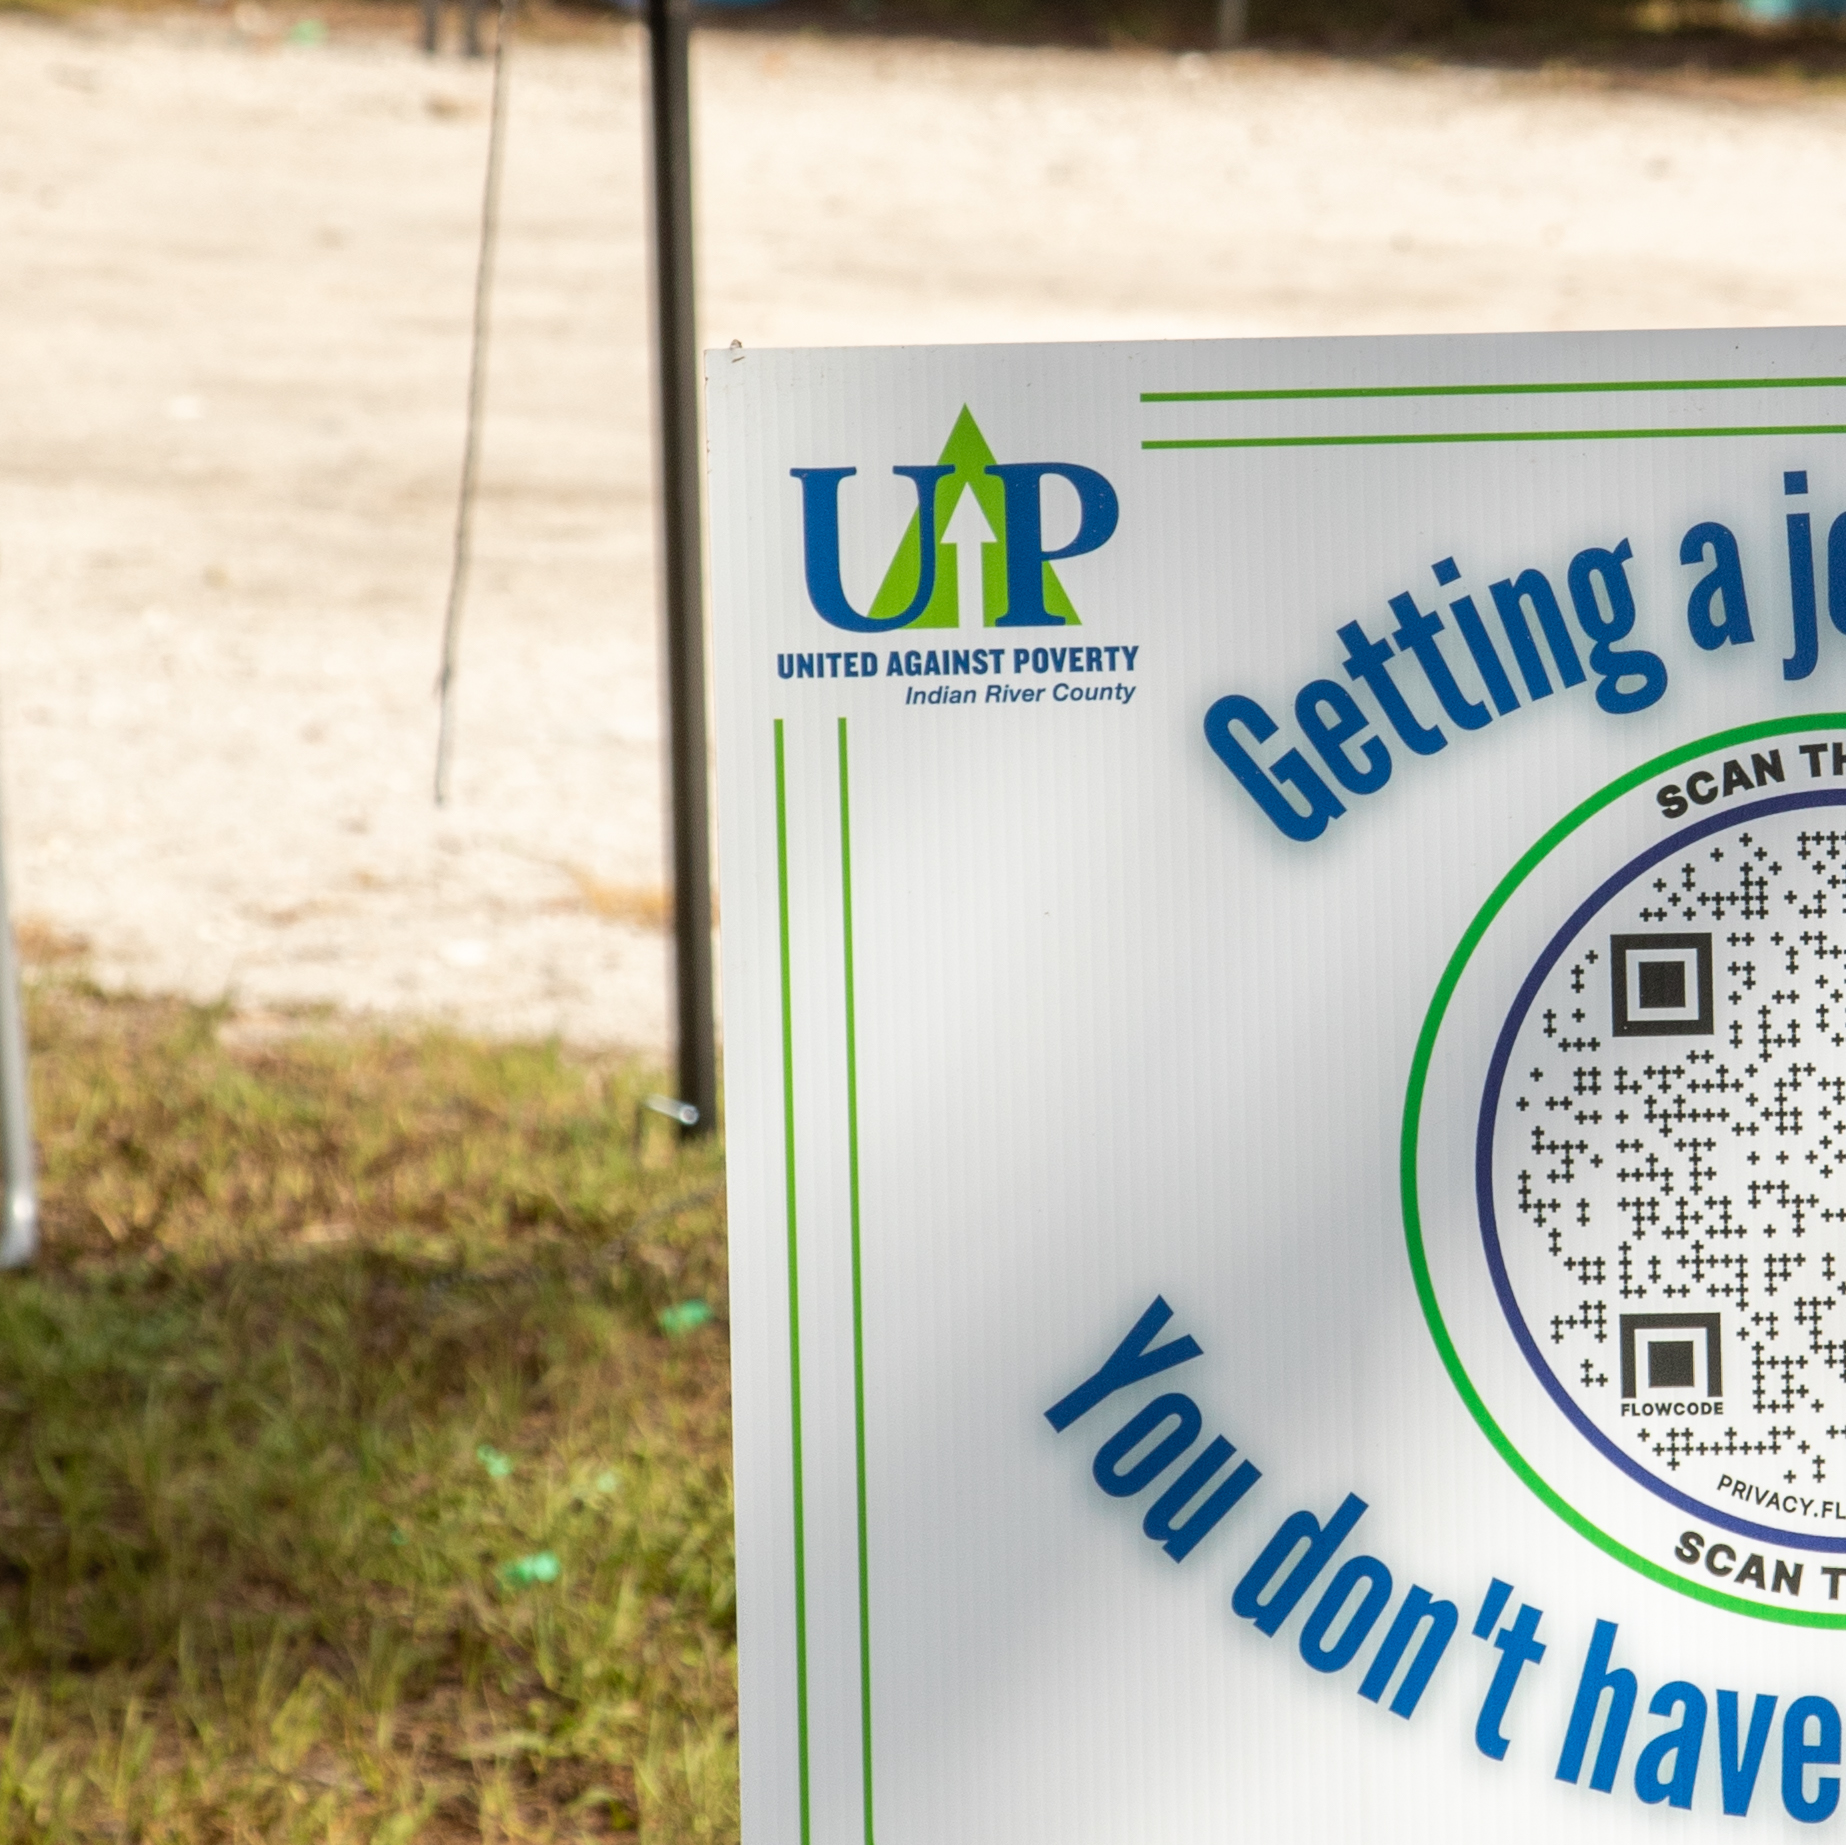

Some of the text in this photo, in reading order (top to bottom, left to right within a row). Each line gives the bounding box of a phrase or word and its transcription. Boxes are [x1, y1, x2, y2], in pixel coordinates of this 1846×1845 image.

[776, 645, 1140, 680] UNITED AGAINST POVERTY
[905, 682, 1137, 705] Indian River County
[1203, 538, 1669, 842] Getting
[1679, 521, 1754, 651] a
[1656, 748, 1787, 820] SCAN
[1620, 1401, 1725, 1417] FLOWCODE
[1043, 1295, 1262, 1563] You
[1231, 1492, 1547, 1762] don't
[1555, 1618, 1843, 1824] have
[1674, 1530, 1805, 1596] SCAN
